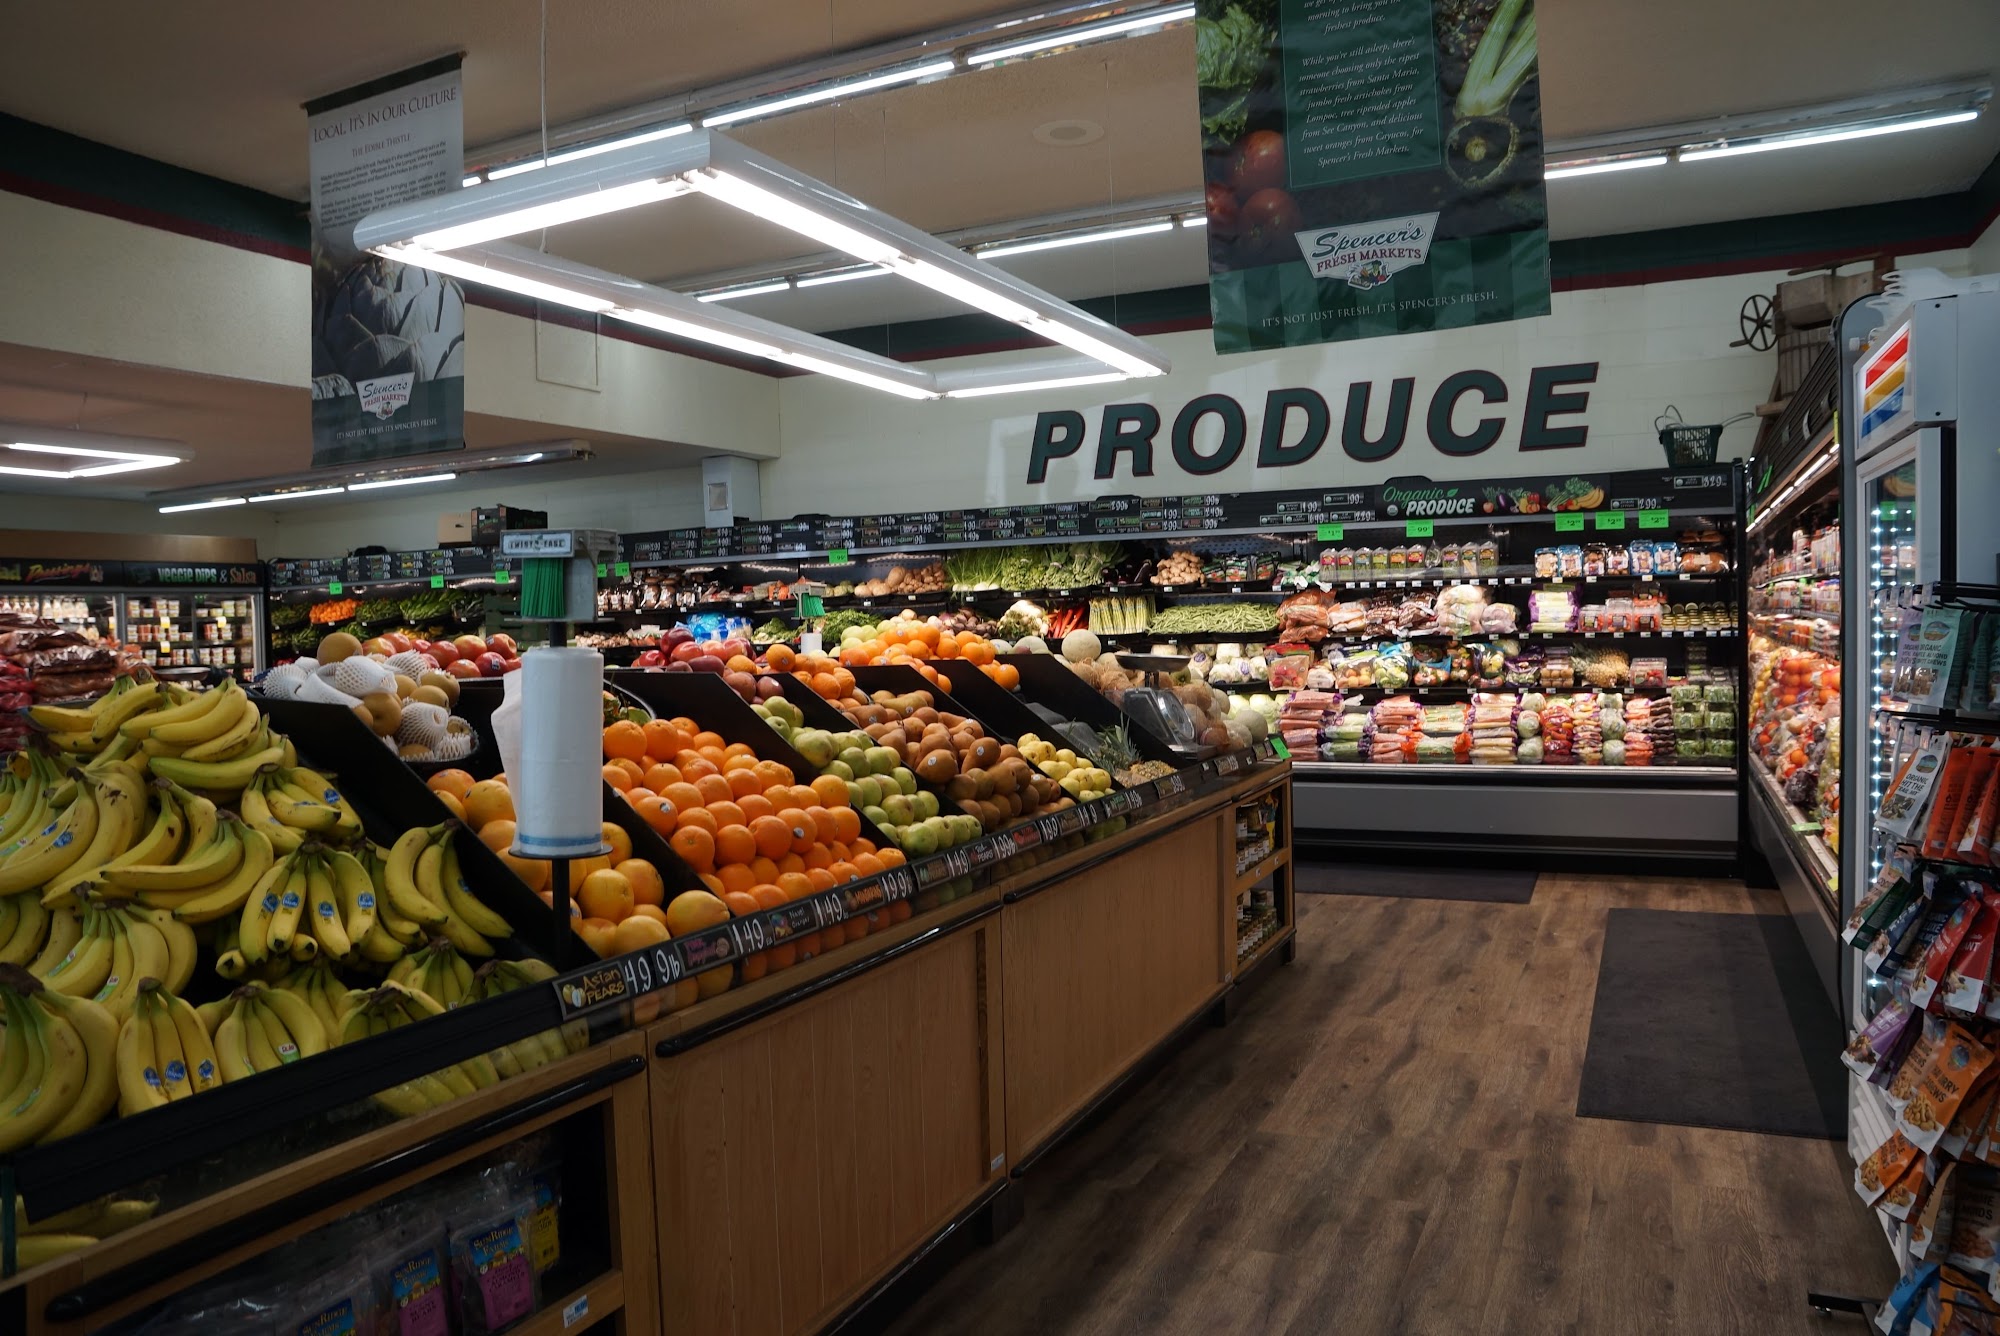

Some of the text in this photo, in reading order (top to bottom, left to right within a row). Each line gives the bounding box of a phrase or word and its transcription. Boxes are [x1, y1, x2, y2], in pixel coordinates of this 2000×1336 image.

[1308, 8, 1340, 21] morning
[1352, 1, 1373, 12] bring
[1374, 0, 1388, 9] you
[1324, 14, 1386, 36] freshest produce.
[1302, 36, 1415, 67] While you're still asleep, there's
[1299, 52, 1420, 82] someone choosing only the ripest
[1300, 66, 1420, 96] strawberries from Santa Maria,
[367, 110, 380, 127] IN
[382, 103, 407, 121] OUR
[408, 87, 457, 112] CULTURE
[1306, 82, 1413, 111] jumbo fresh artichokes from
[1306, 112, 1338, 124] Lompoc,
[1341, 108, 1354, 117] tree
[1392, 96, 1416, 110] apples
[1301, 111, 1423, 141] from See Canyon, and delicious
[352, 146, 364, 158] THE
[1303, 126, 1424, 154] sweet oranges from Cayucos, for
[1317, 143, 1410, 168] Spencer's Fresh Markets.
[1311, 220, 1426, 259] Spencer's
[1317, 247, 1422, 273] FRESH MARKETS
[1262, 290, 1499, 328] IT'S NOT JUST FRESH. IT'S SPENCER'S FRESH.
[363, 377, 408, 398] Spencer's
[364, 393, 408, 408] FRESH MARKETS
[345, 430, 356, 438] NOT
[1026, 361, 1600, 484] PRODUCE
[1383, 486, 1444, 507] Organic
[1406, 497, 1476, 516] PRODUCE
[229, 566, 258, 585] Salsa
[585, 981, 625, 1006] PEARS
